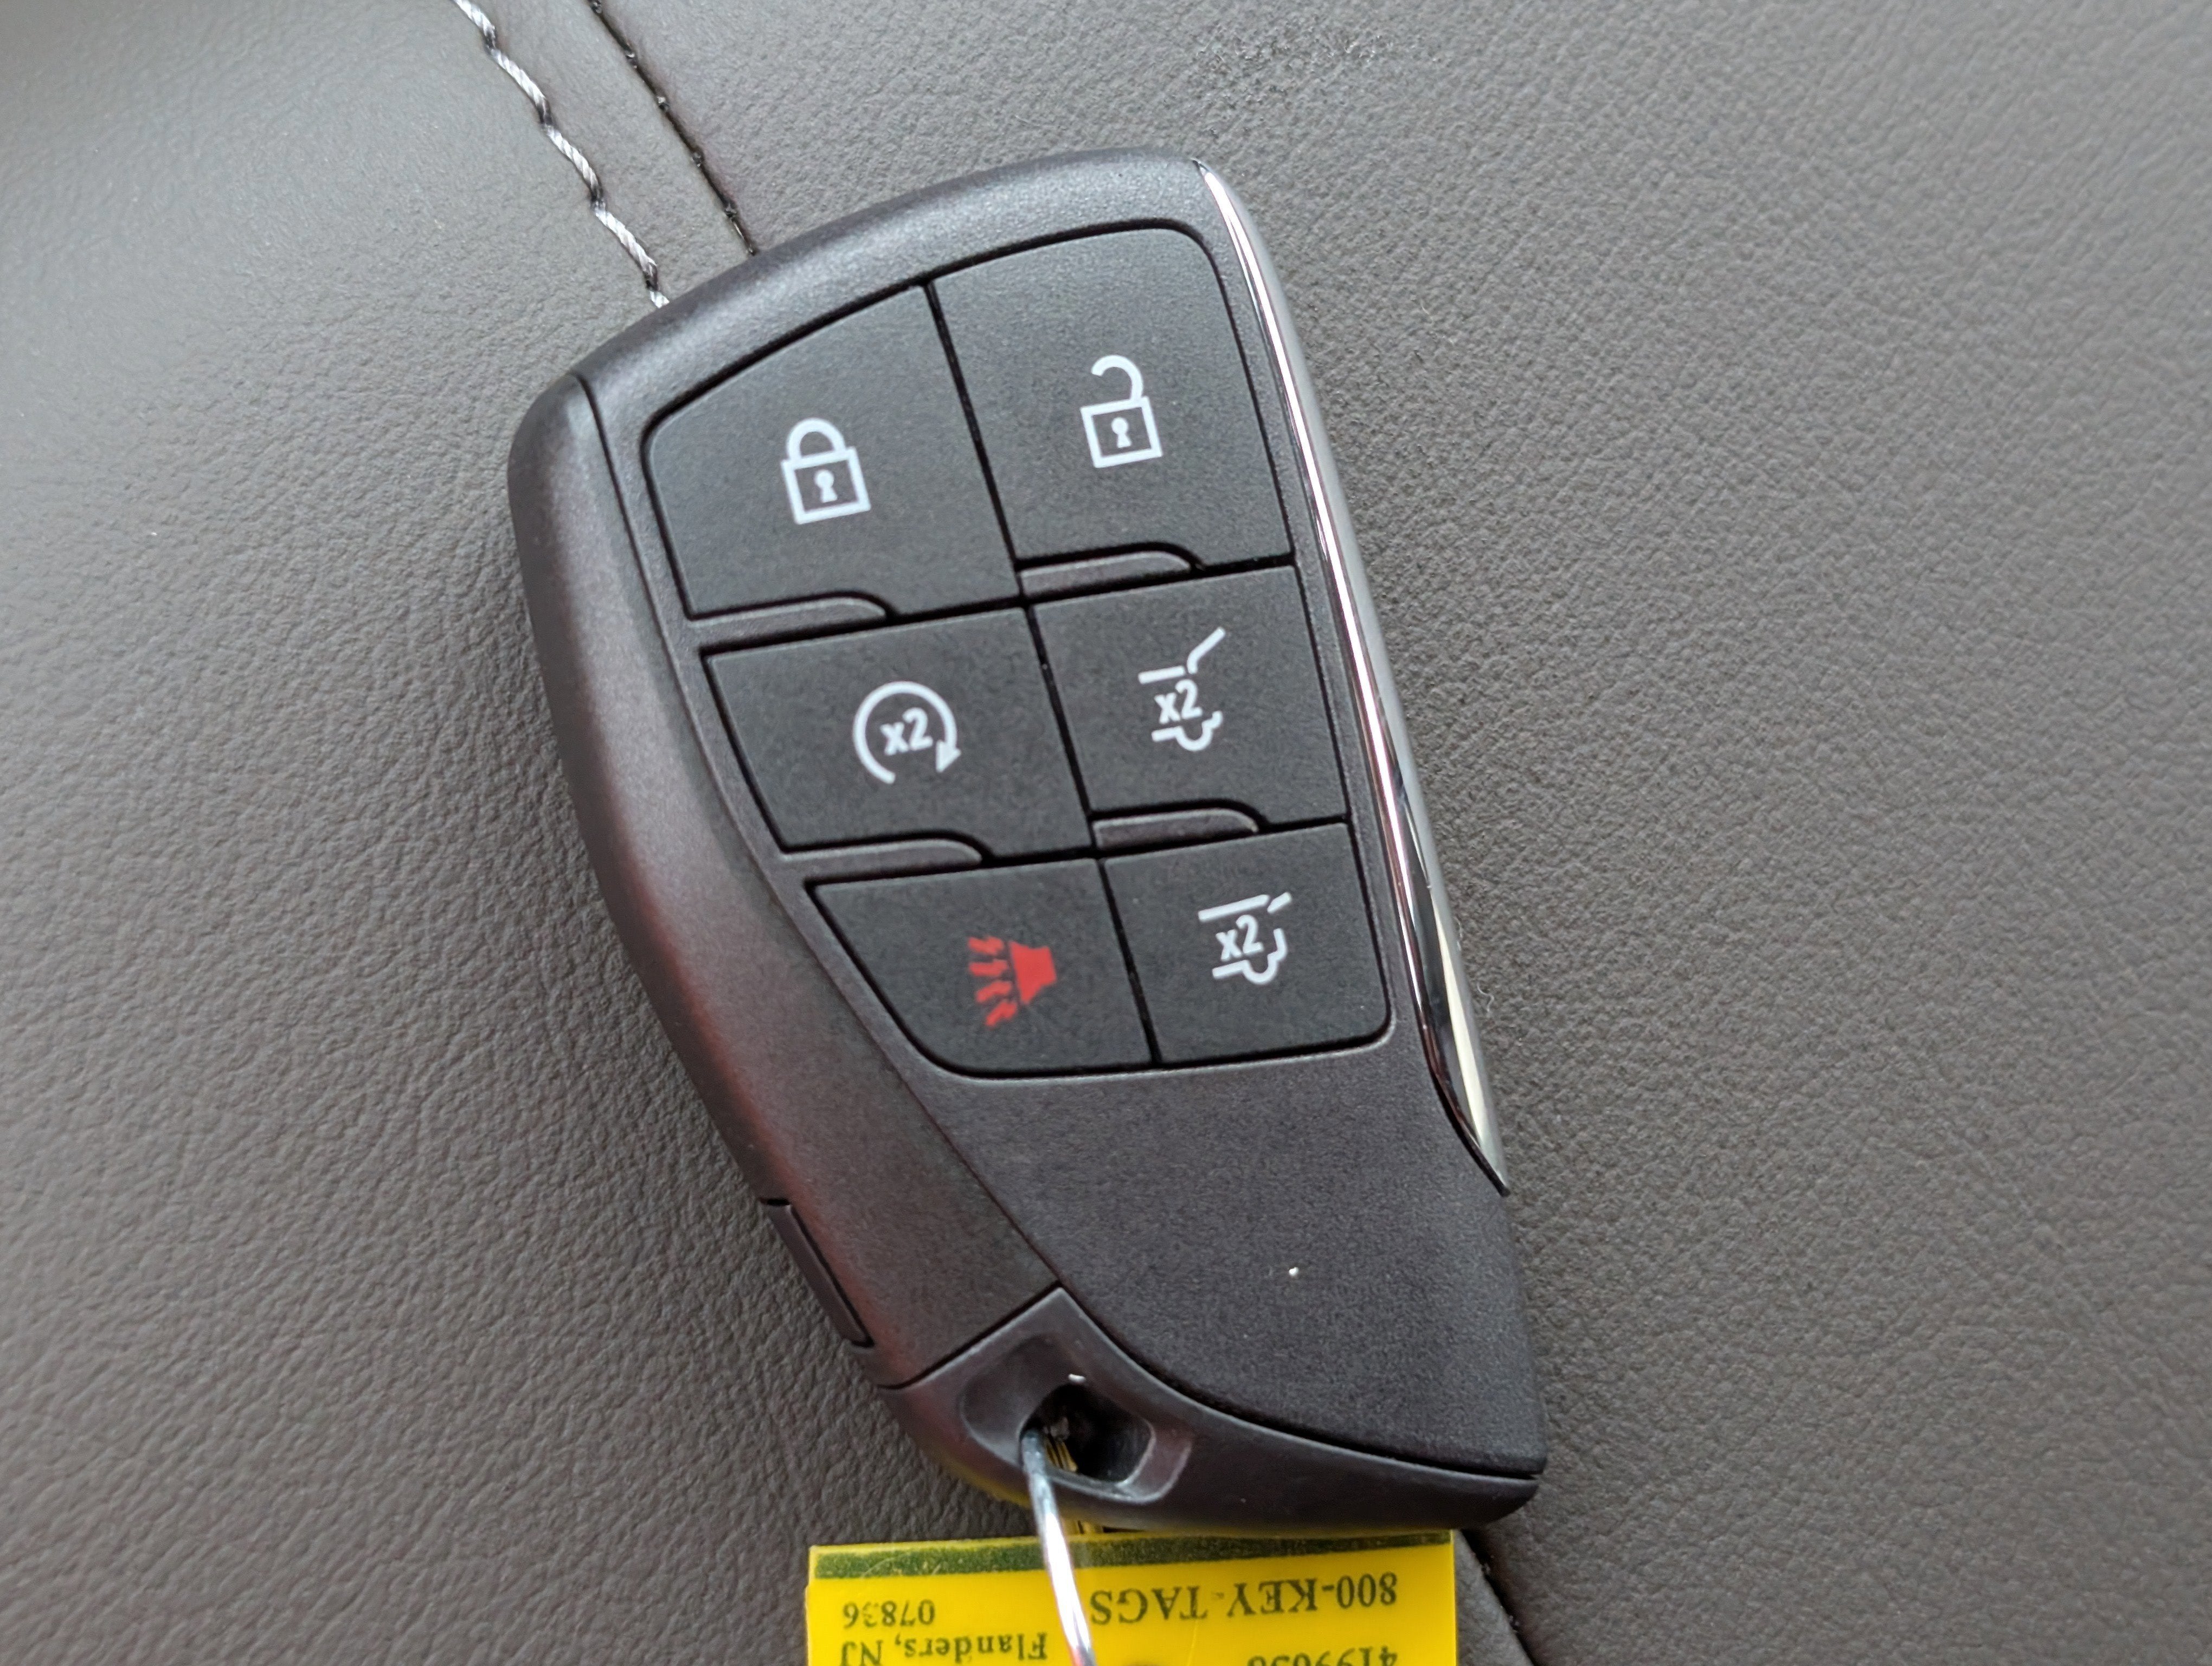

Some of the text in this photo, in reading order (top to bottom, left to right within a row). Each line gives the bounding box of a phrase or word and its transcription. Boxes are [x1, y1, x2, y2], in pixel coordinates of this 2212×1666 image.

[843, 1599, 935, 1628] 07836
[841, 1632, 1047, 1666] Flanders, NJ
